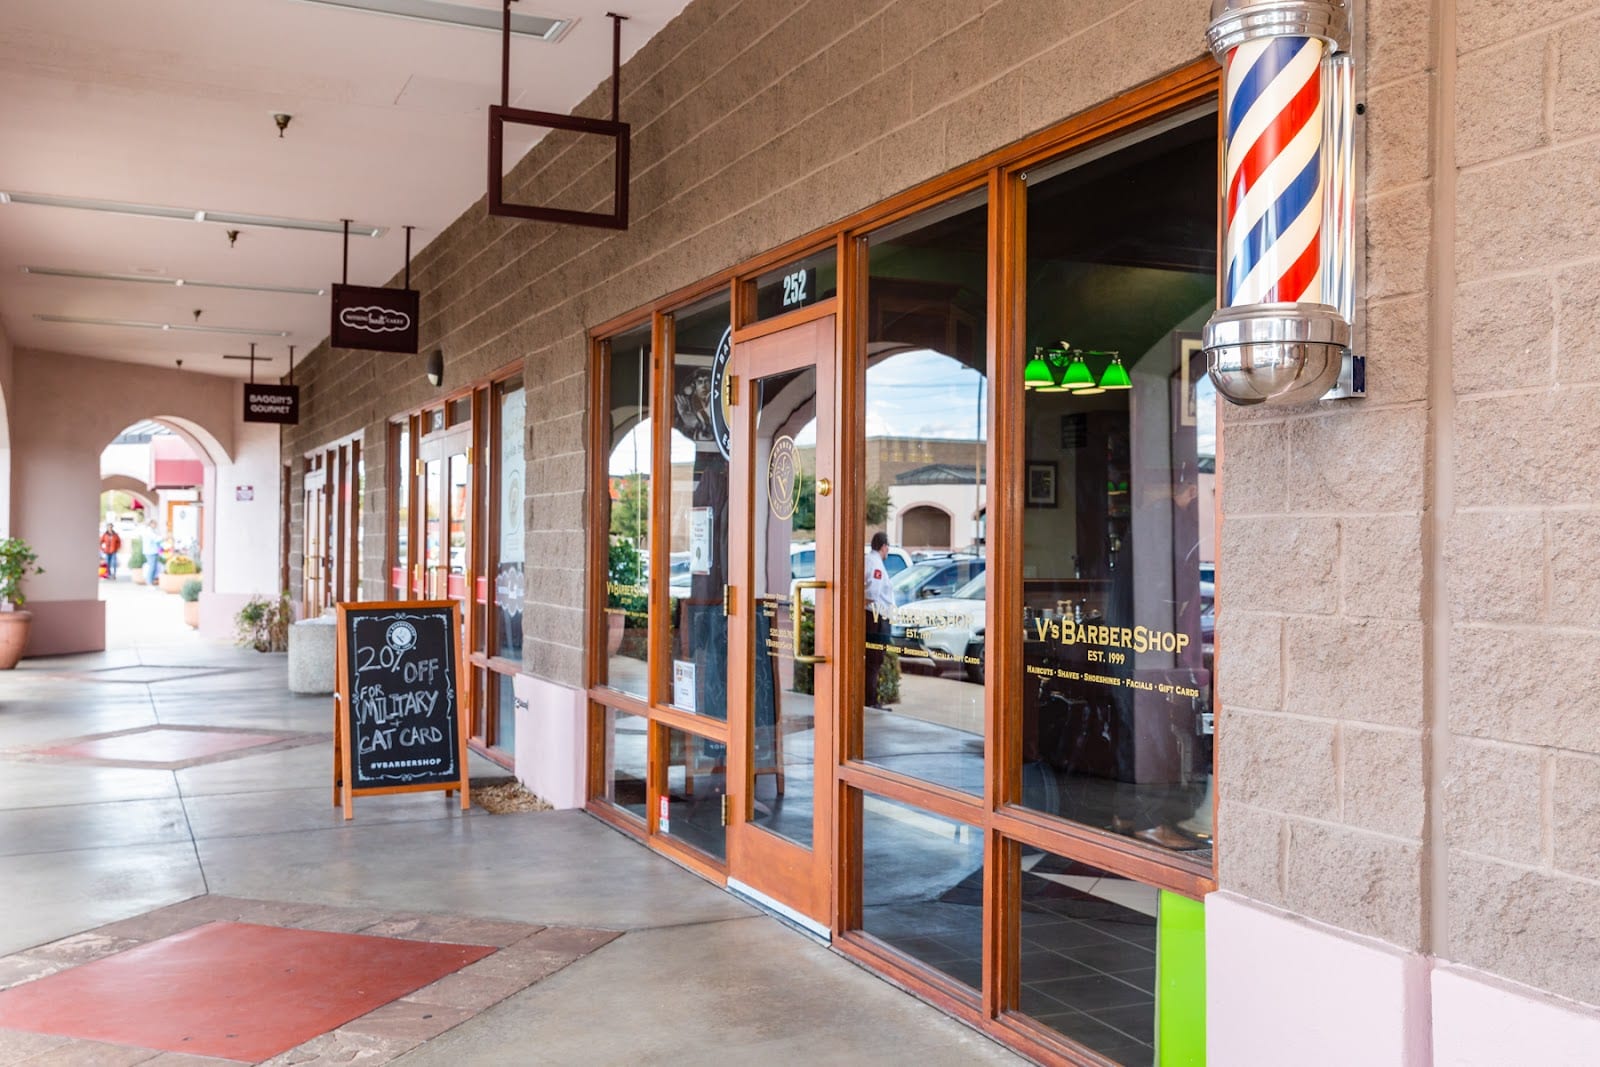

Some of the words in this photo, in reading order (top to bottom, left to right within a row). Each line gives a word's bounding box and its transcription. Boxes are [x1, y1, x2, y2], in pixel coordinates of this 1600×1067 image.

[783, 269, 807, 306] 252
[250, 404, 291, 414] GOURMET
[1061, 619, 1190, 654] BARBERSHOP
[357, 645, 404, 673] 20%
[404, 658, 439, 685] OFF
[1087, 650, 1106, 663] EST.
[1108, 651, 1125, 665] 1999
[360, 683, 385, 700] FOR
[1026, 664, 1054, 676] HAIRCUTS
[1057, 668, 1080, 680] SHAVES
[1083, 672, 1121, 686] SHOESHINES
[1125, 678, 1153, 691] FACIALS
[1158, 683, 1174, 695] GIFT
[1175, 686, 1200, 698] CARDS
[361, 690, 439, 725] MILITARY
[359, 728, 397, 754] CAT
[399, 726, 443, 747] CARD
